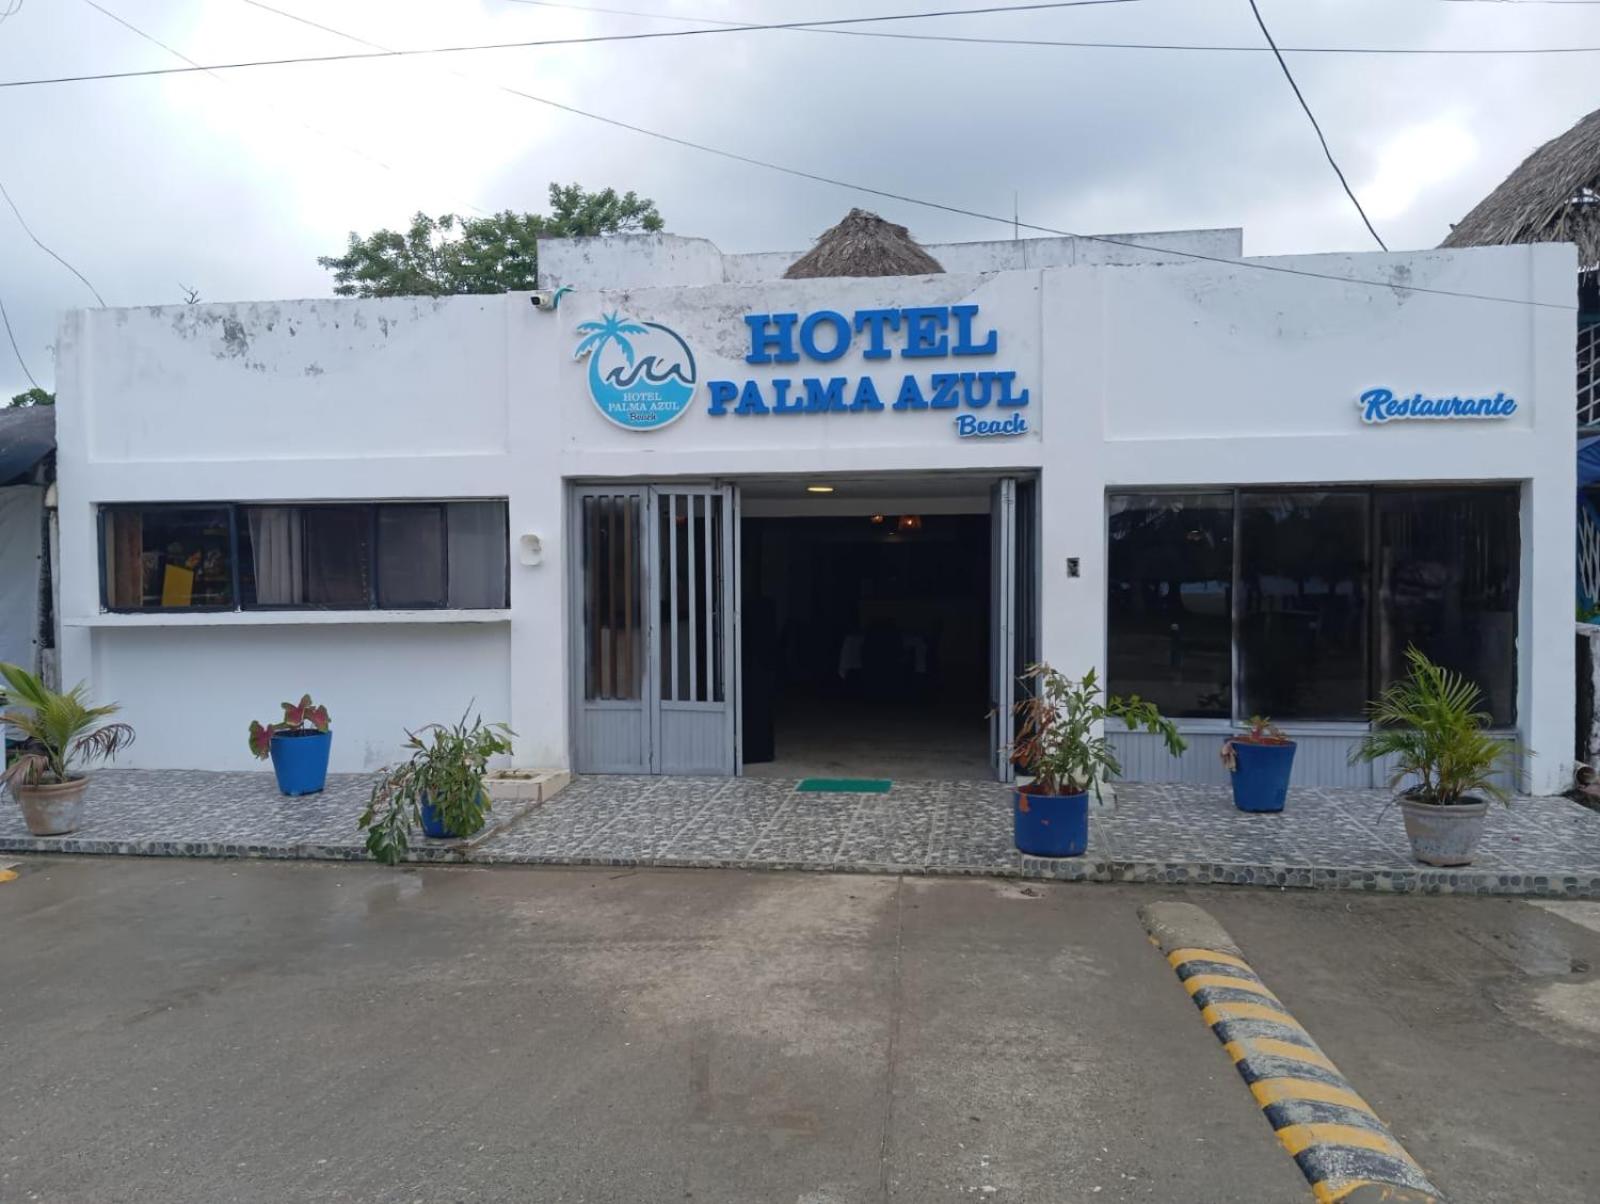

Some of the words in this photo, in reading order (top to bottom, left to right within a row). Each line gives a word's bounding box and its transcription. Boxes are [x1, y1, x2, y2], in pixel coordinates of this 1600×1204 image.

[744, 304, 998, 365] HOTEL
[608, 402, 648, 412] PALMA
[648, 401, 680, 411] AZUL
[623, 392, 662, 402] HOTEL
[707, 376, 885, 416] PALMA
[892, 371, 1030, 411] AZUL
[1360, 388, 1517, 421] Restaurante
[956, 412, 1028, 436] Beach
